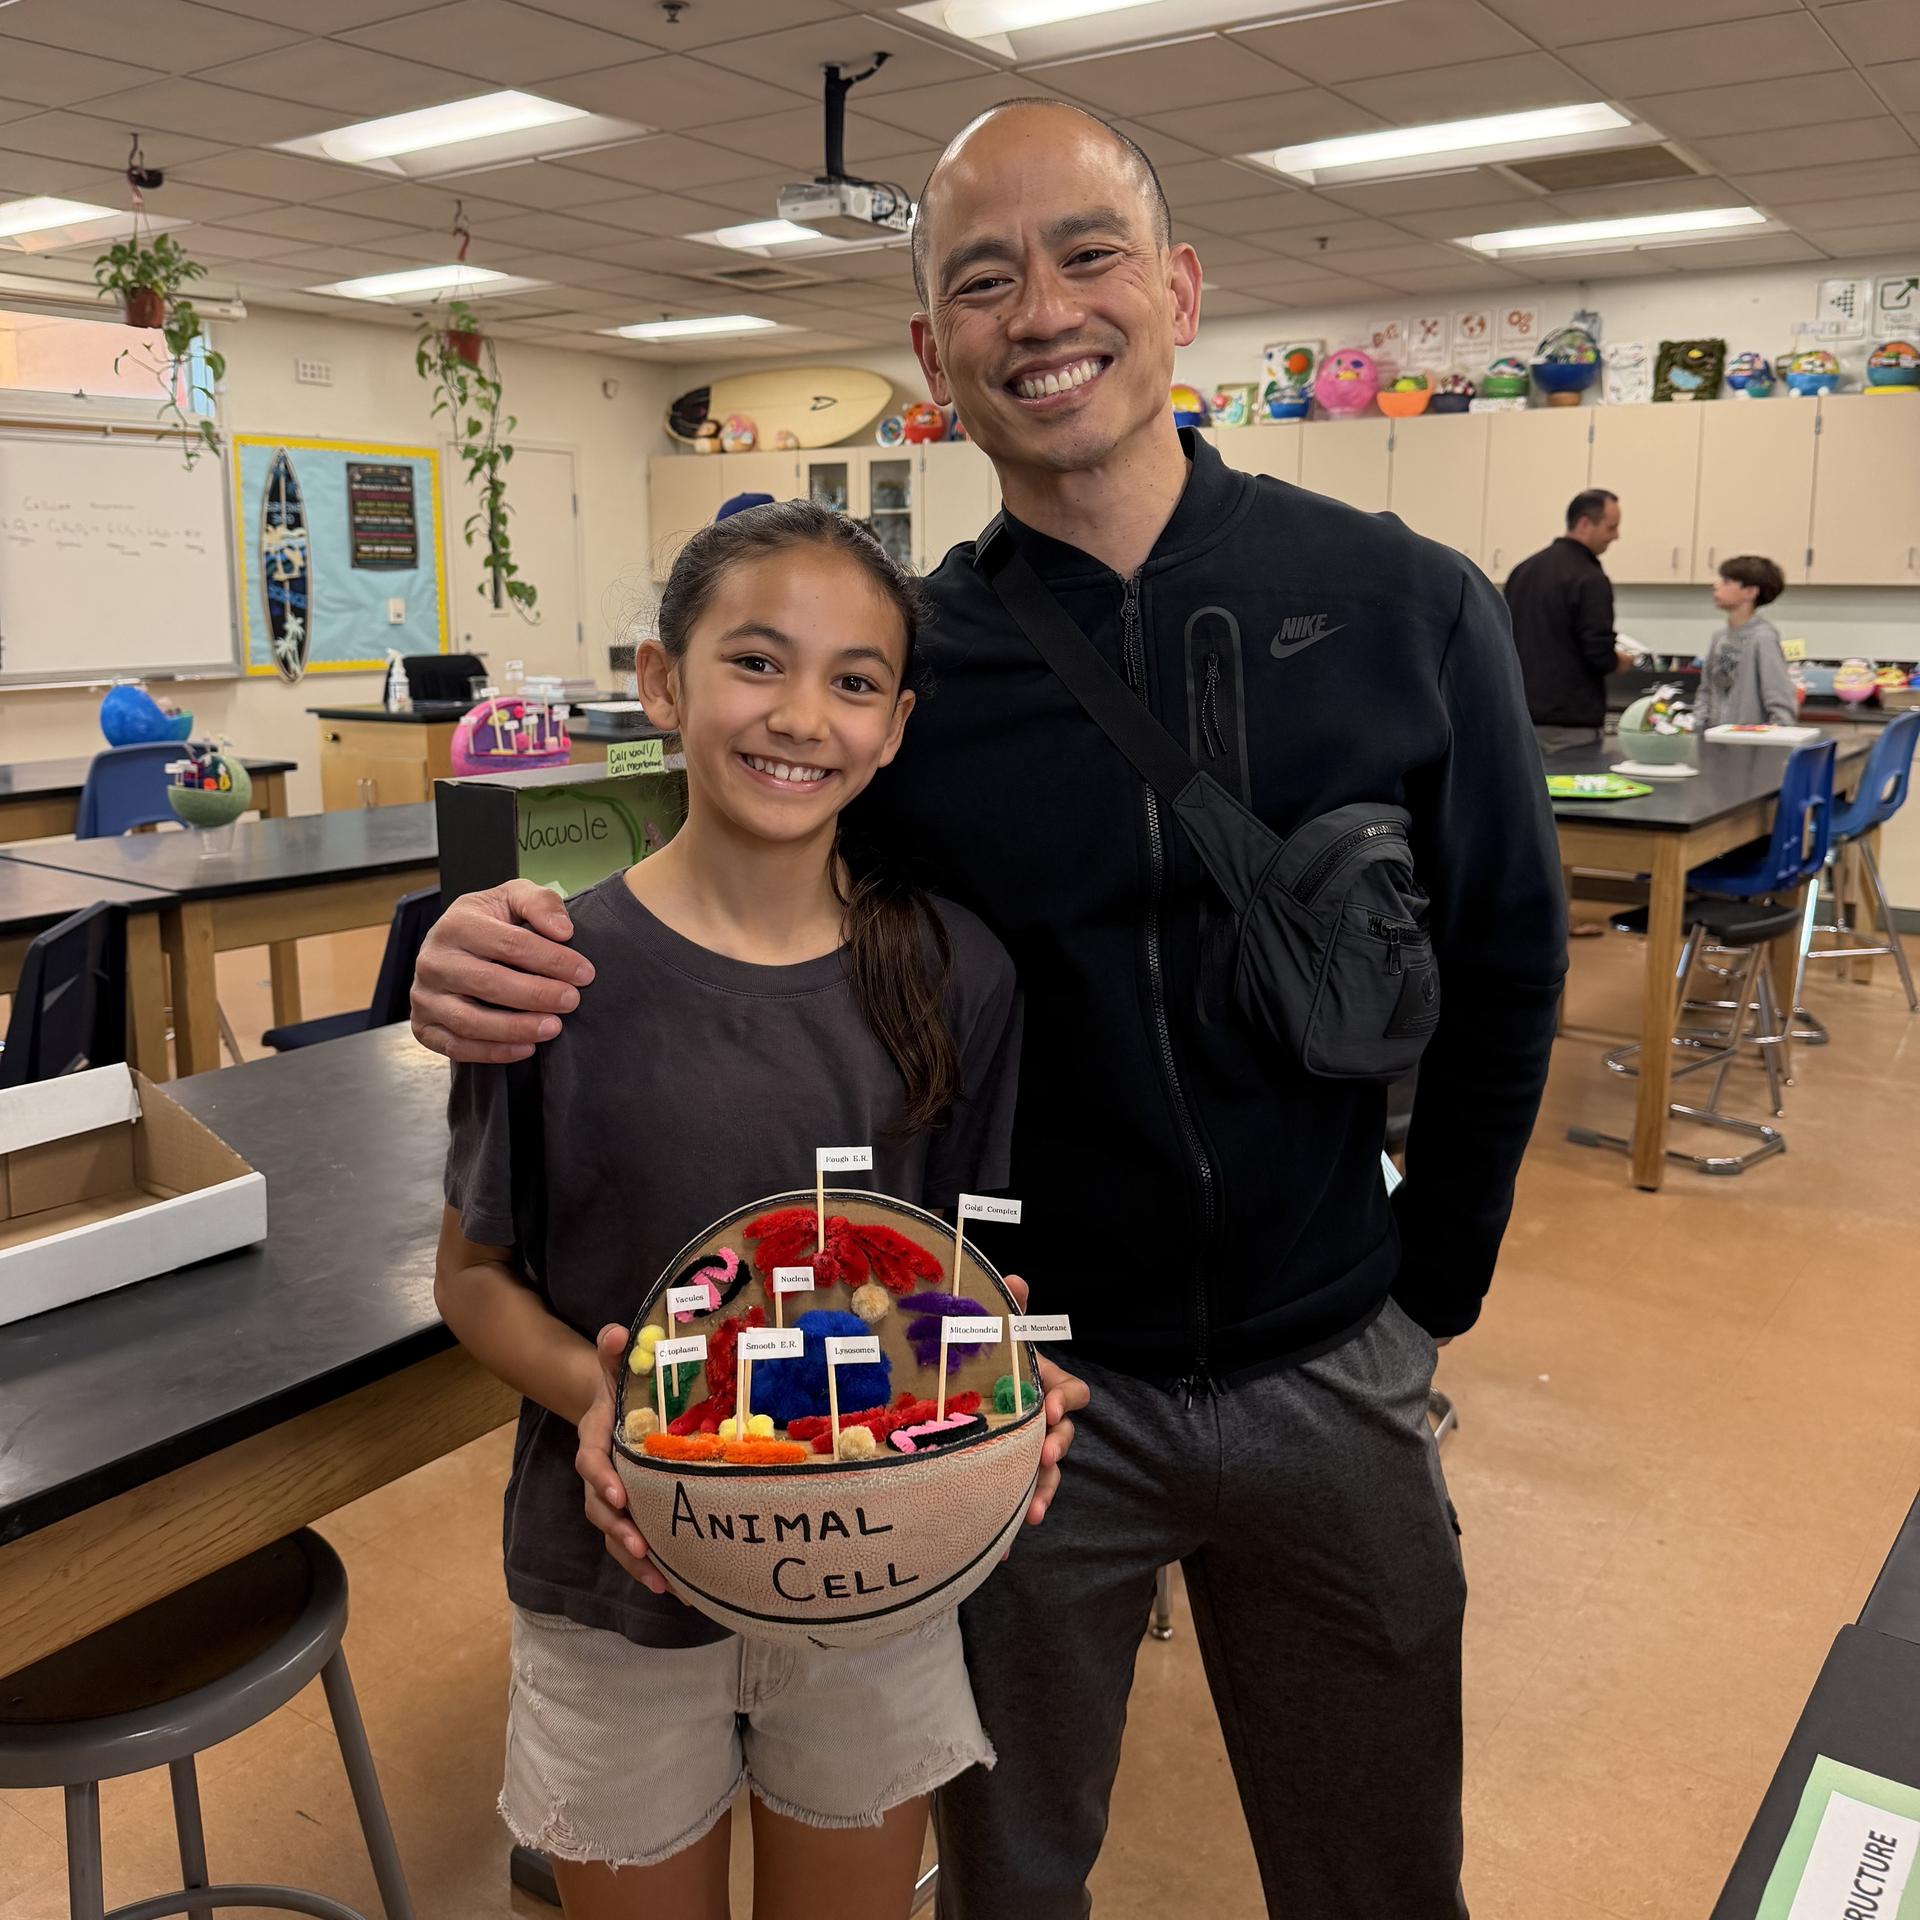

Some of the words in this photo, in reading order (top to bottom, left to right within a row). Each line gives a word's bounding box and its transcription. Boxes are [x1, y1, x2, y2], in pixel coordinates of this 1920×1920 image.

[1280, 613, 1328, 640] NIKE
[610, 749, 627, 764] Cell
[518, 808, 608, 852] Vacuole
[853, 1154, 869, 1163] E.R.
[964, 1203, 983, 1212] Golgi
[987, 1205, 1018, 1217] Complex
[781, 1275, 810, 1284] Nucleus
[675, 1294, 704, 1305] Vacules
[950, 1325, 999, 1335] Mitochondria
[1013, 1323, 1027, 1332] Cell
[1030, 1323, 1067, 1332] Membrane
[745, 1341, 776, 1351] Smooth
[780, 1340, 797, 1349] E.R.
[834, 1345, 875, 1356] Lysosomes
[671, 1480, 894, 1544] ANIMAL
[772, 1557, 920, 1602] CELL
[1842, 1829, 1898, 1920] RUCTURE
